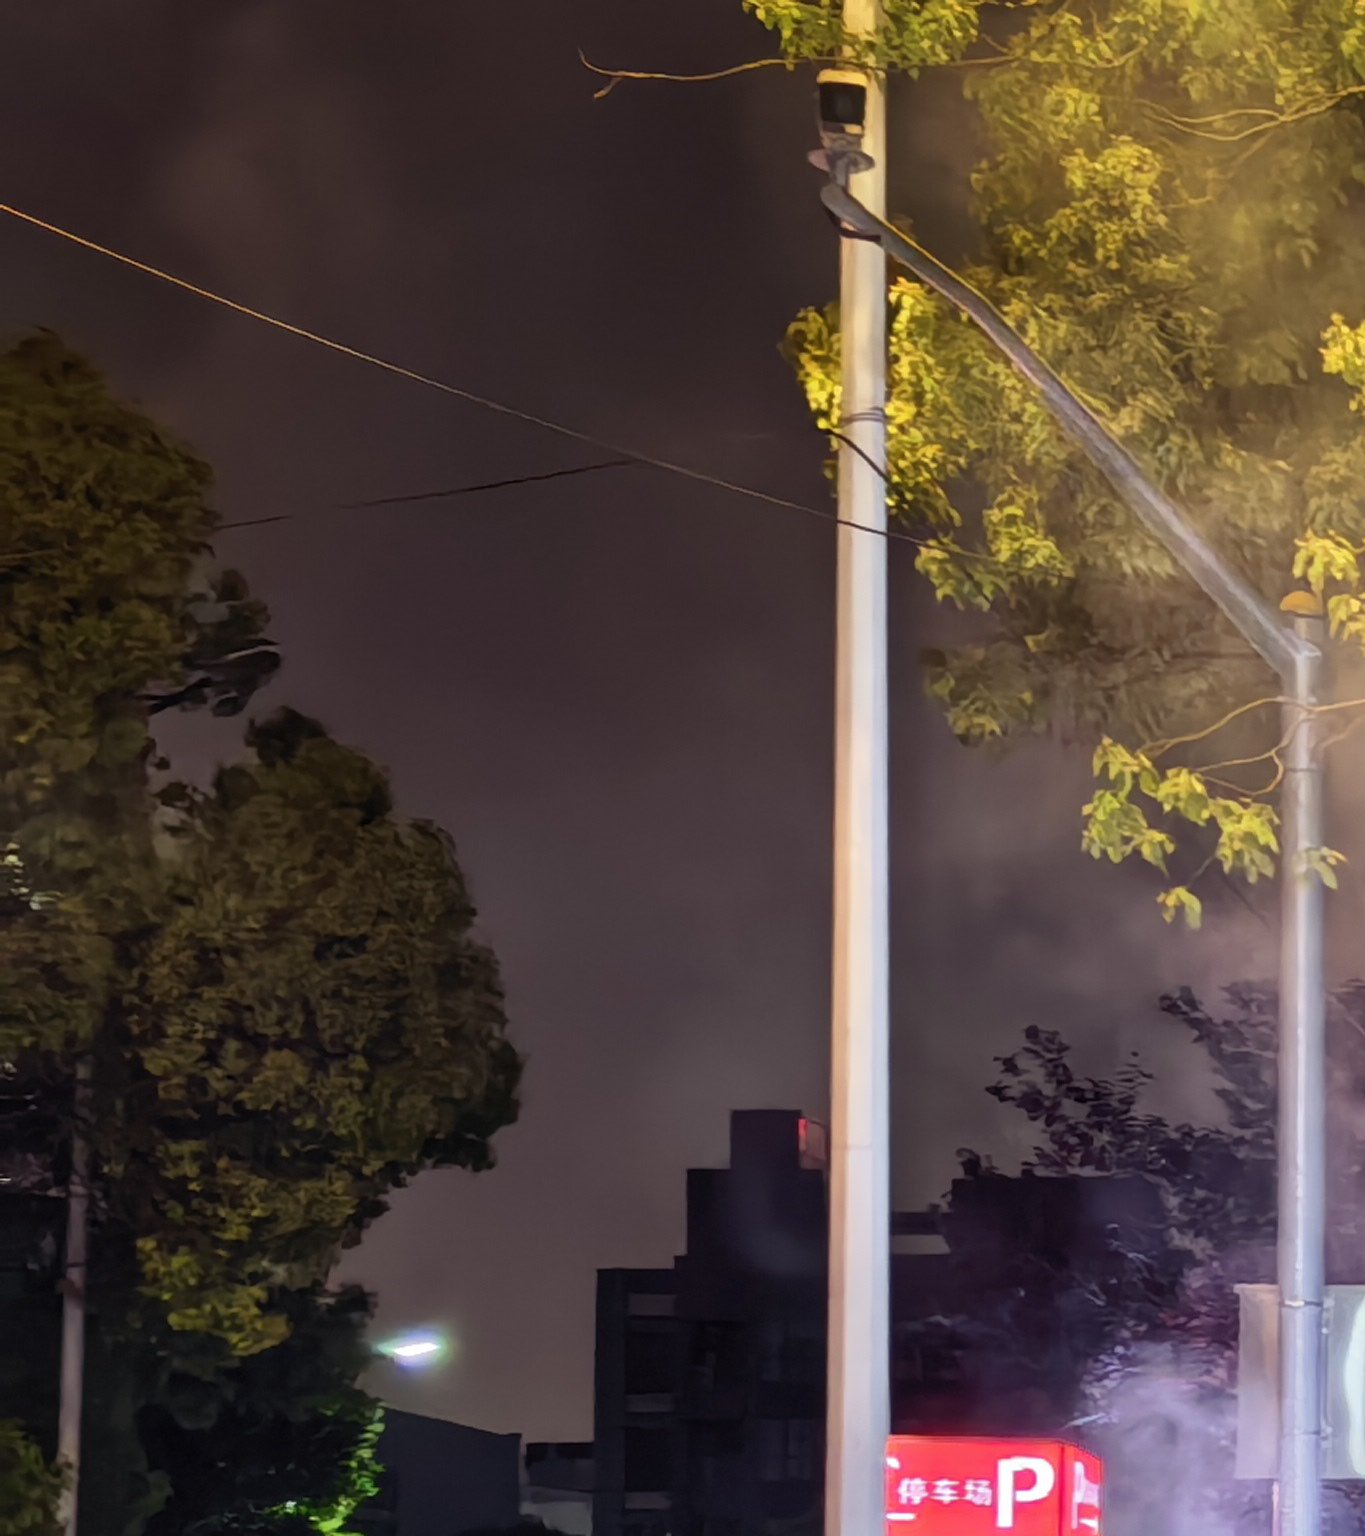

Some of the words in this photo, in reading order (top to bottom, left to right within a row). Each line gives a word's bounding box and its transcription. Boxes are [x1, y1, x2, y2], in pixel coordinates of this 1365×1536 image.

[898, 1478, 992, 1506] 停车场
[996, 1456, 1055, 1527] P
